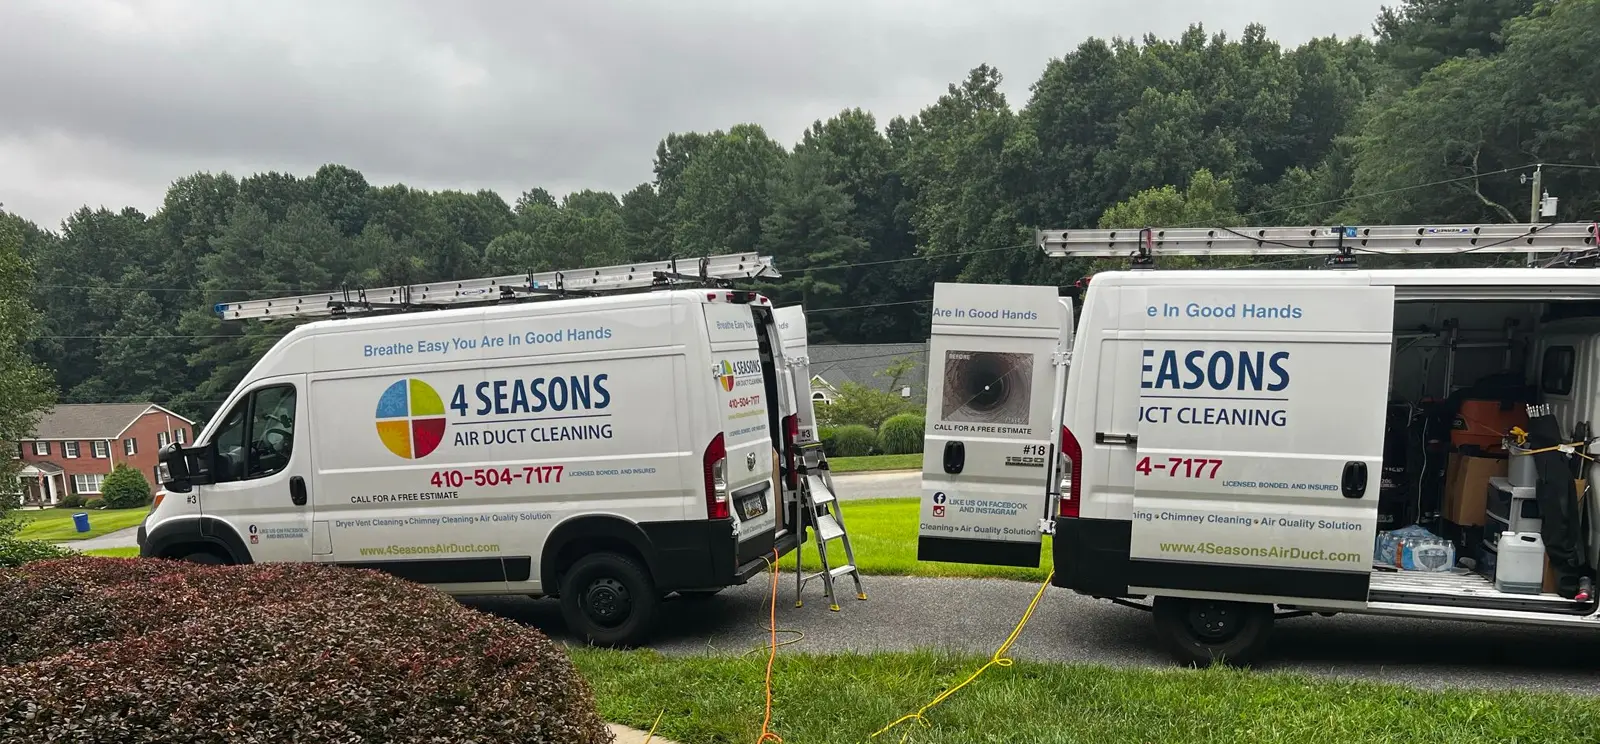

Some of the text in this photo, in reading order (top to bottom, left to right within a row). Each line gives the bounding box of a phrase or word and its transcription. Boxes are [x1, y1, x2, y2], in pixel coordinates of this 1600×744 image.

[933, 308, 1037, 320] Are In Good Hands
[1147, 303, 1303, 319] e In Good Hands
[363, 327, 612, 357] Breathe Easy You Are In Good Hands
[733, 360, 760, 375] 4 SEASONS
[450, 373, 611, 416] 4 SEASONS
[1177, 407, 1286, 426] CLEANING
[454, 424, 613, 447] AIR DUCT CLEANING
[1023, 445, 1045, 455] #18
[1136, 457, 1223, 479] 4-7177
[430, 466, 564, 488] 410-504-7177
[1308, 483, 1338, 491] INSURED
[187, 495, 197, 504] #3
[351, 491, 458, 504] CALL FOR A FREE ESTIMATE
[976, 508, 1017, 516] INSTAGRAM
[990, 502, 1028, 510] FACEBOOK
[335, 512, 552, 530] Dryer Vent Cleaning Chimney Cleaning Air Quality Solution
[1161, 512, 1204, 524] Chimney
[1207, 514, 1252, 526] Cleaning
[1260, 517, 1276, 526] Air
[1279, 518, 1315, 530] Quality
[1318, 520, 1362, 531] Solution
[920, 523, 954, 532] Cleaning
[974, 525, 1001, 535] Quality
[360, 543, 500, 556] www.4SeasonsAirDuct.com
[1160, 542, 1361, 562] www.4SeasonsAirDuct.com
